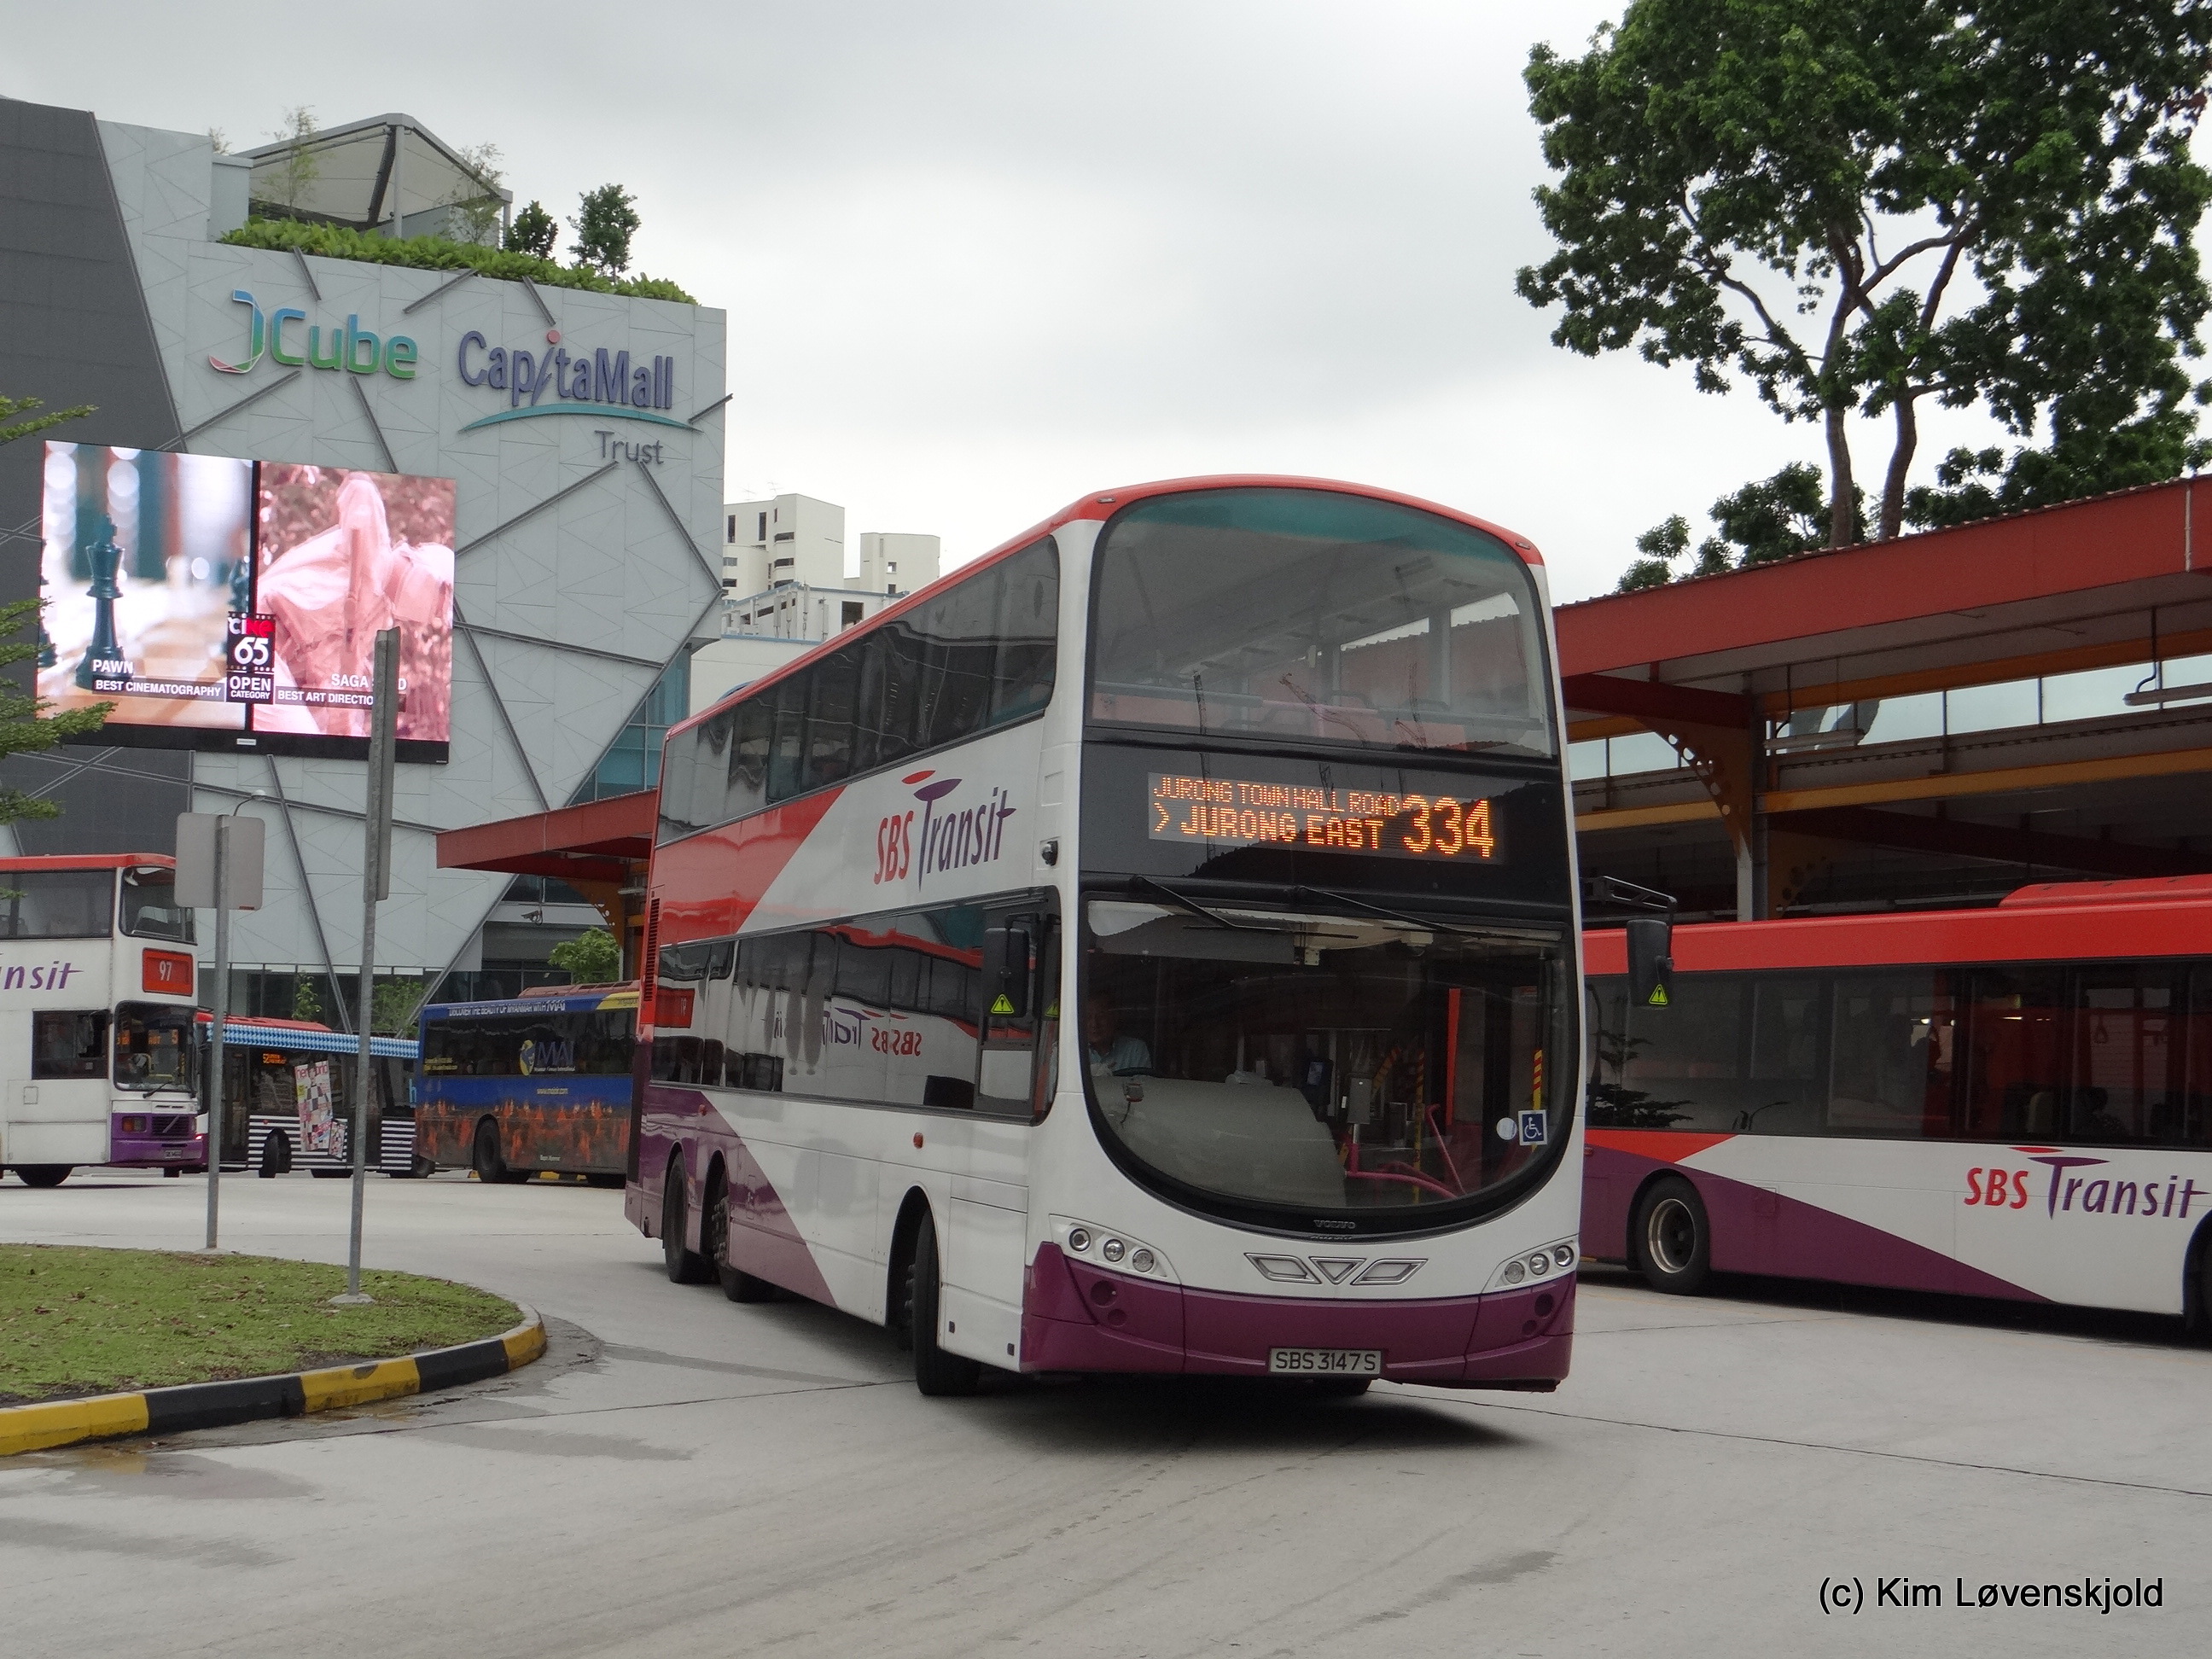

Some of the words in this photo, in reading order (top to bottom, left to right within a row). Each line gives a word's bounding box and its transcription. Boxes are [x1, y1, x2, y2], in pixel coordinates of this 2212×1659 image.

[458, 329, 673, 409] CapitaMall
[595, 430, 664, 463] Trust
[234, 637, 269, 665] 65
[92, 660, 134, 674] PAWN
[331, 673, 369, 688] SAGA
[96, 680, 124, 691] BEST
[126, 682, 221, 696] CINEMATOGRAPHY
[230, 676, 271, 691] OPEN
[230, 690, 271, 700] CATEGORY
[277, 690, 304, 701] BEST
[306, 692, 327, 703] ART
[328, 694, 374, 705] DIRECTIO
[1154, 777, 1232, 802] JURONG
[1237, 783, 1289, 807] TOWN
[1293, 788, 1344, 812] HALL
[1349, 793, 1400, 817] ROAD
[874, 810, 914, 885] SBS
[913, 778, 1017, 893] Transit
[1181, 806, 1296, 842] JURONG
[1307, 815, 1384, 850] EAST
[1402, 795, 1493, 858] 334
[0, 960, 84, 990] nsit
[159, 961, 172, 981] 97
[1964, 1167, 2029, 1210] SBS
[2027, 1156, 2211, 1220] Transit
[1313, 1220, 1356, 1230] VOLVO
